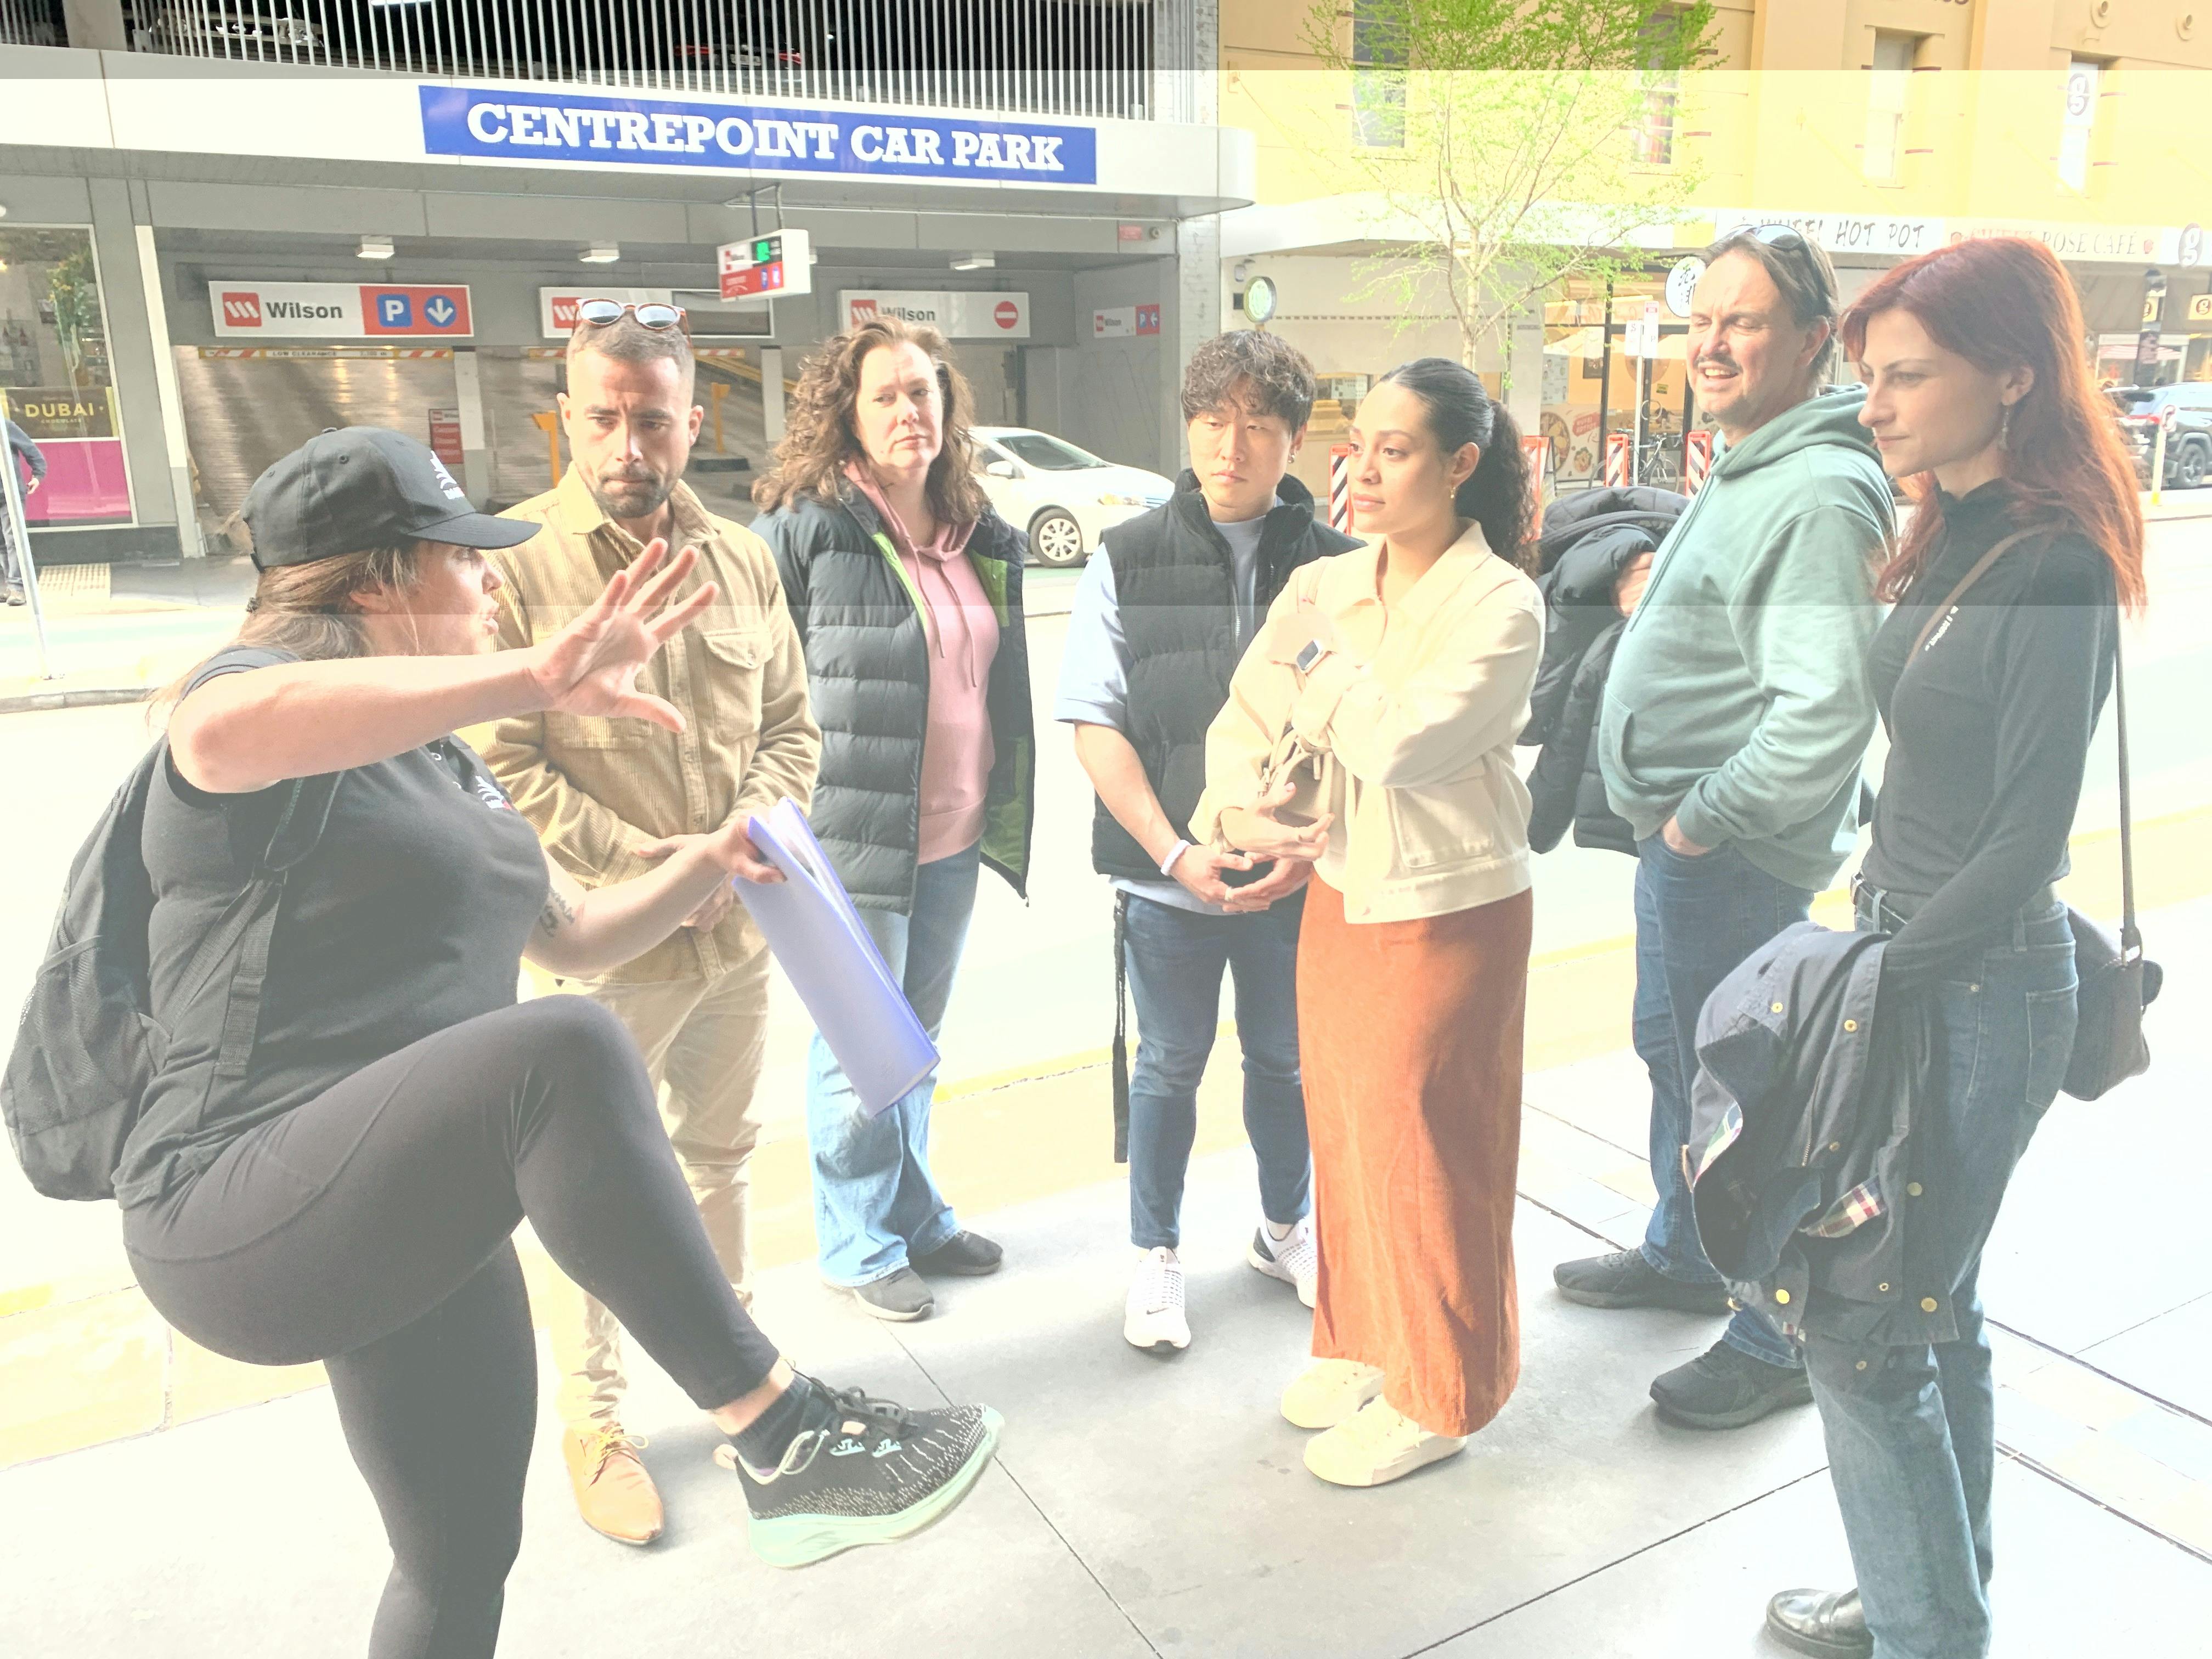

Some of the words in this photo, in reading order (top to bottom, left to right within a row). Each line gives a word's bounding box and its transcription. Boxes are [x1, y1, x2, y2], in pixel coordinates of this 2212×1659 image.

[467, 102, 839, 159] CENTREPOINT
[850, 125, 944, 165] CAR
[952, 131, 1064, 171] PARK
[1836, 220, 1876, 247] HOT
[1889, 223, 1925, 248] POT
[2094, 230, 2137, 254] CAFÉ
[266, 302, 343, 319] Wilson
[25, 402, 94, 417] DUBAI
